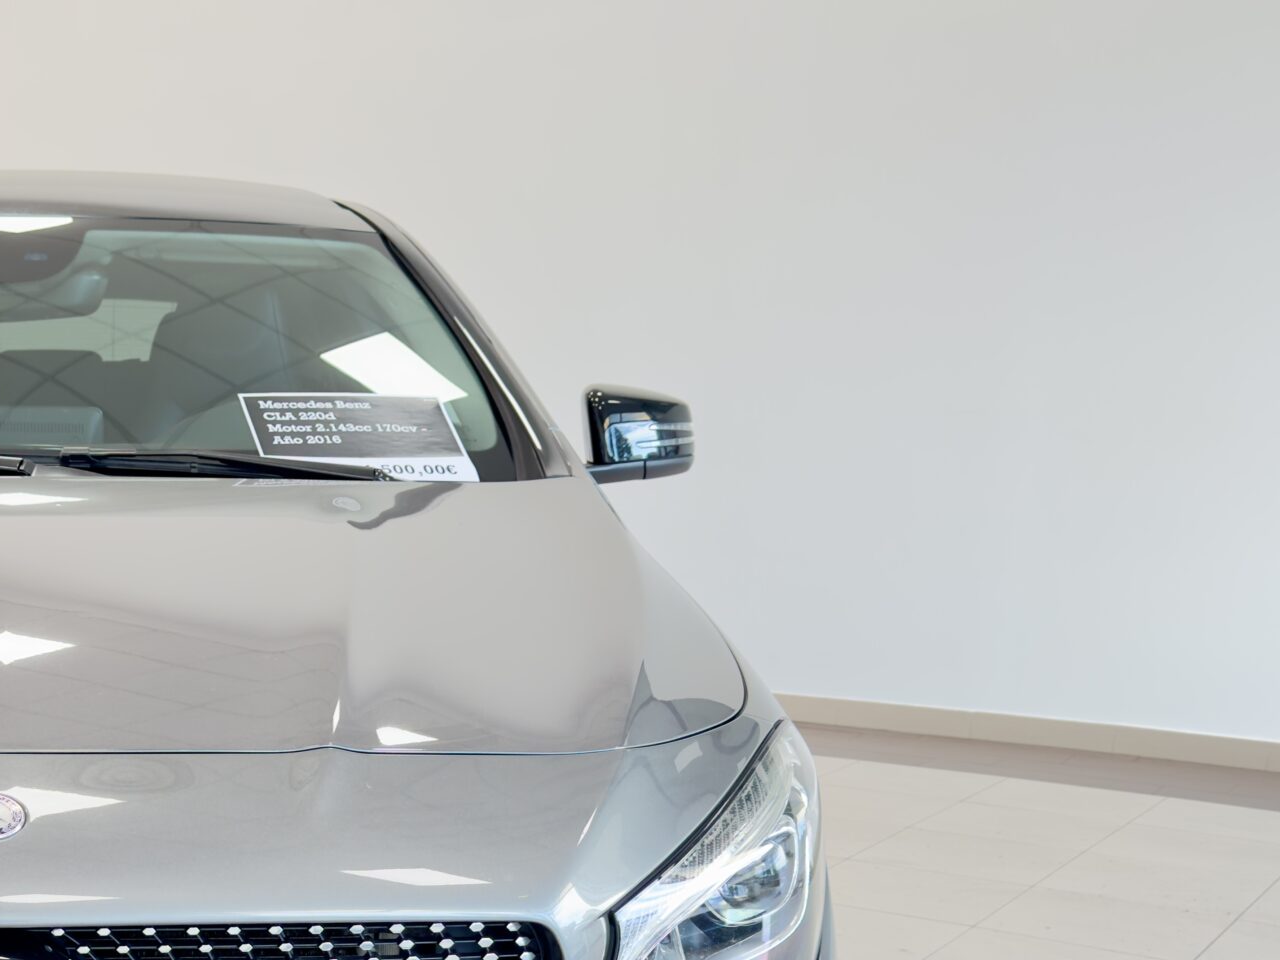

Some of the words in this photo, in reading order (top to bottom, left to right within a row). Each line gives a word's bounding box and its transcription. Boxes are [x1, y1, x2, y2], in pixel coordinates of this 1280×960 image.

[257, 400, 333, 409] Mercedes
[334, 400, 372, 409] Benz
[263, 412, 297, 421] CLA
[299, 411, 337, 420] 220d
[267, 424, 313, 432] Motor
[315, 423, 372, 432] 2.143cc
[376, 424, 418, 432] 170cv
[273, 435, 304, 445] Año
[306, 435, 342, 444] 2016
[381, 464, 458, 476] 500,00€
